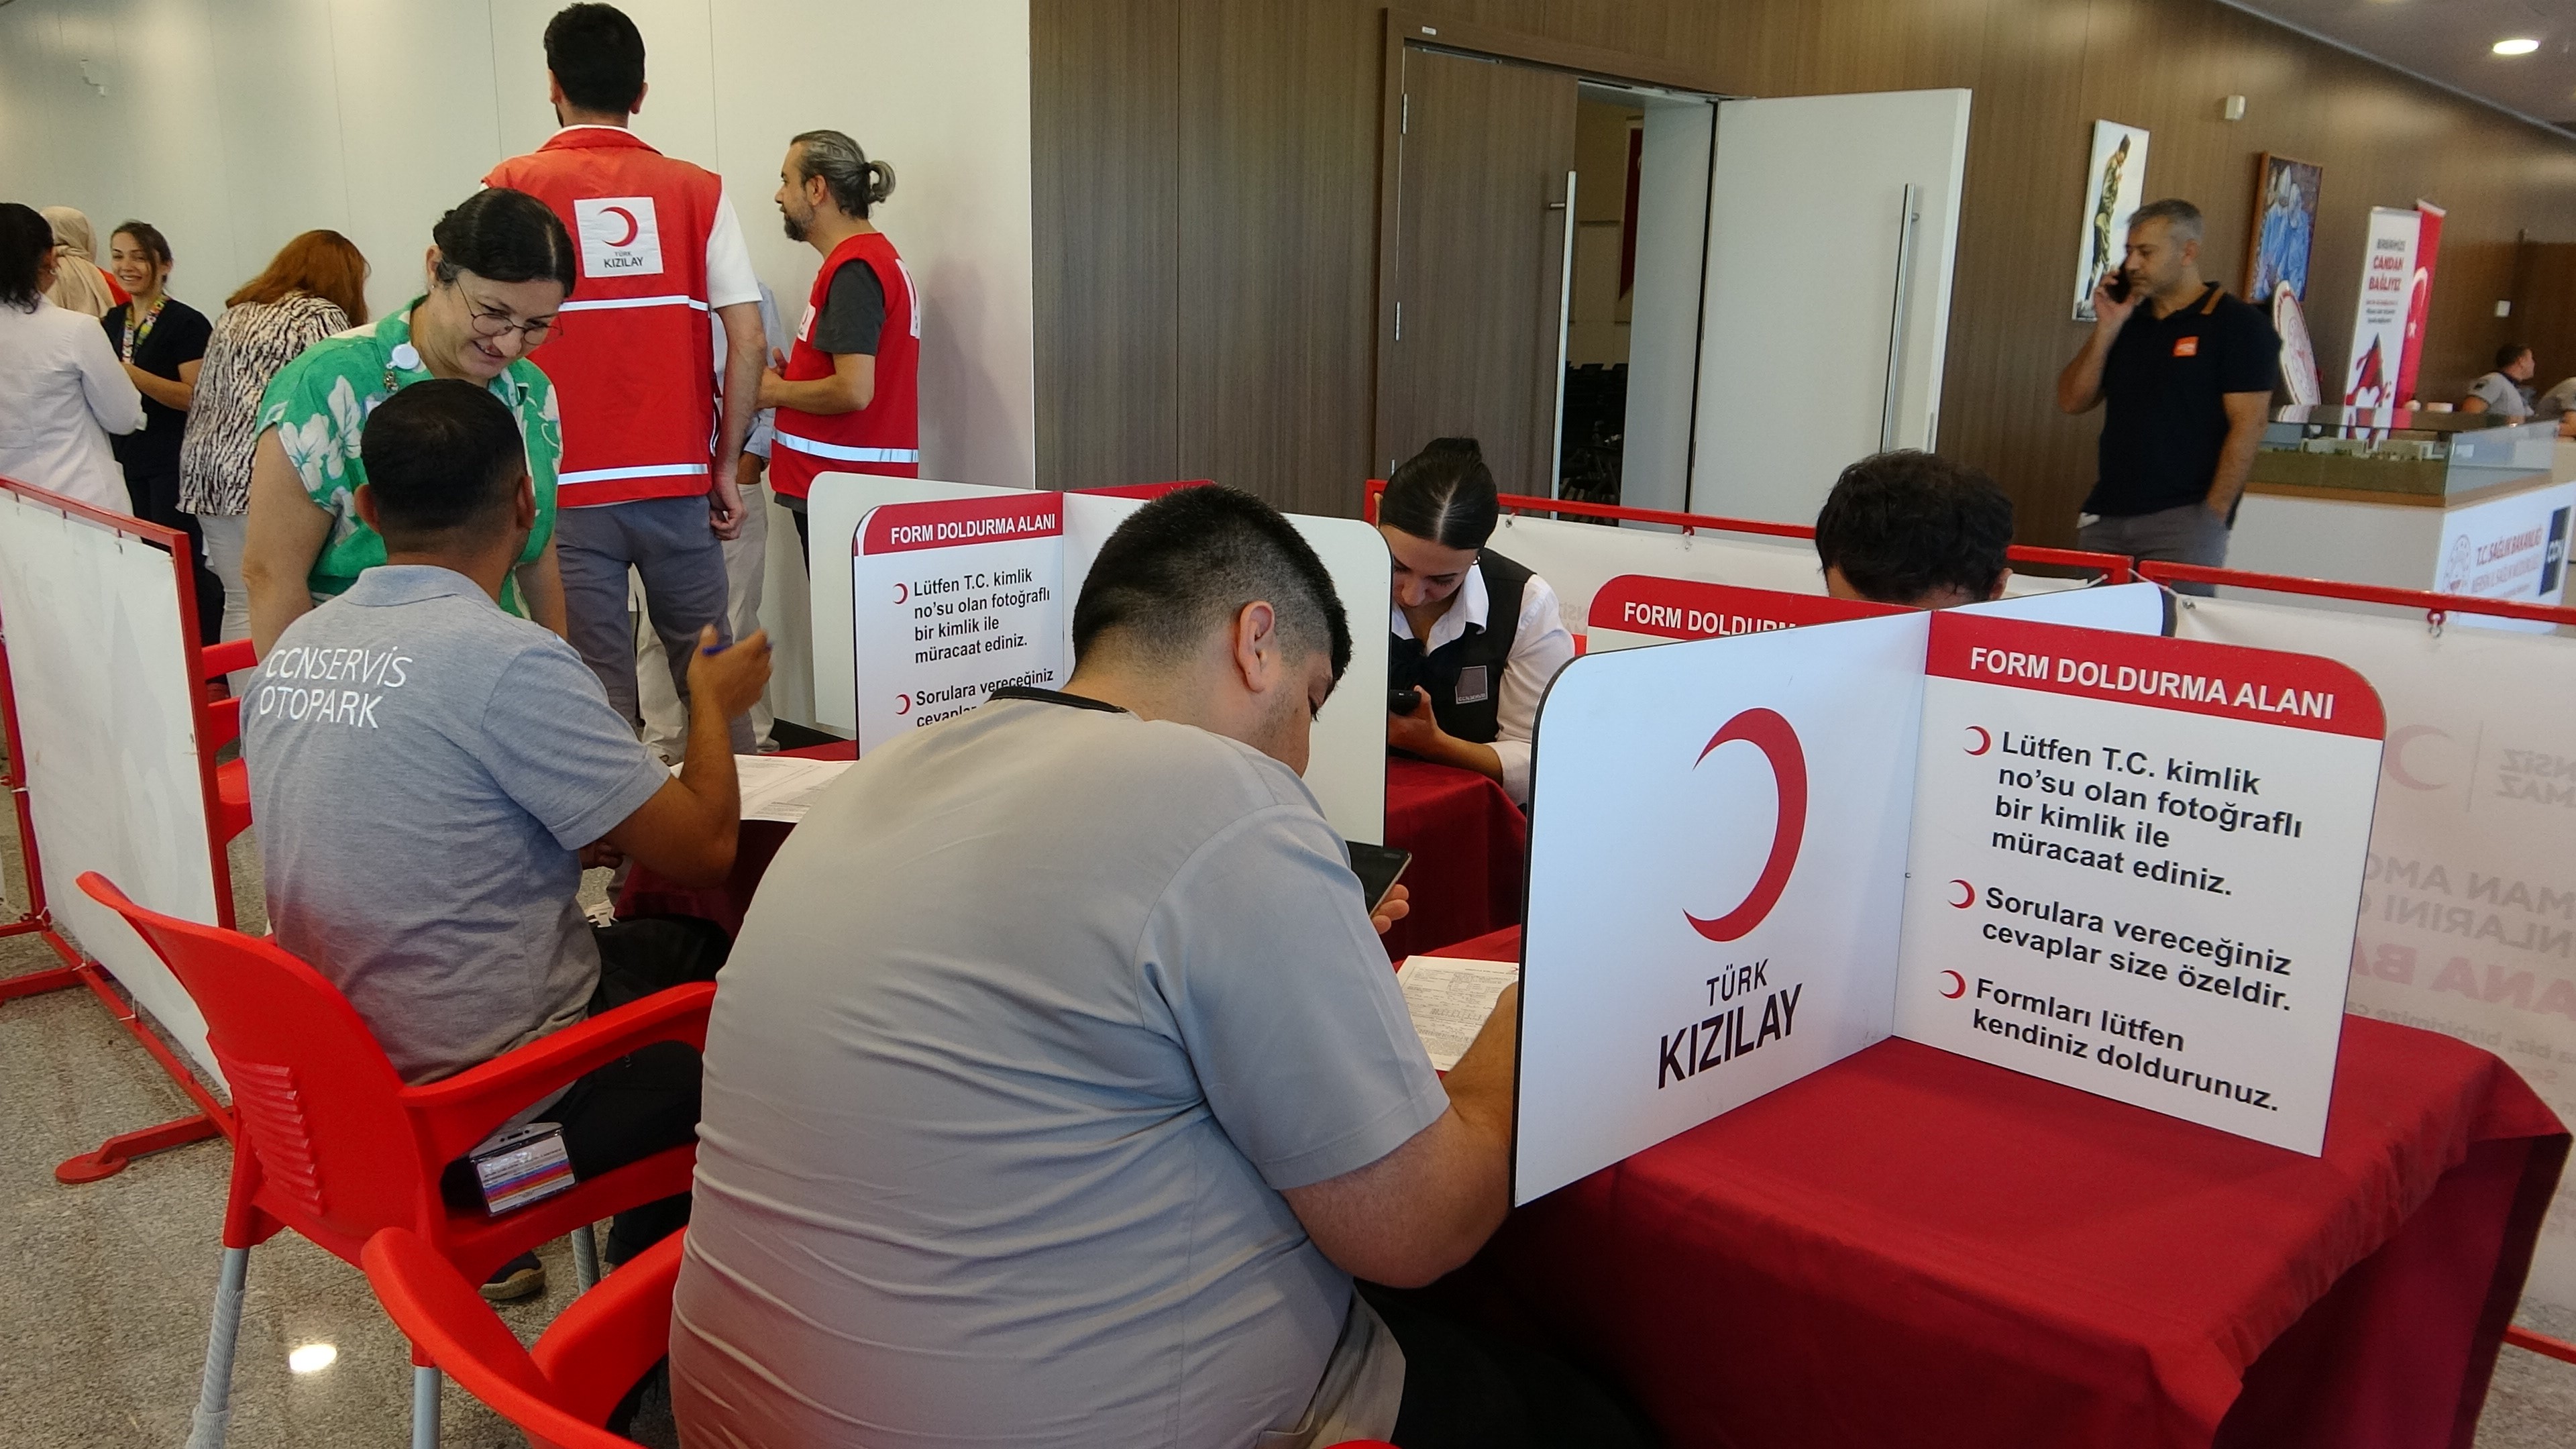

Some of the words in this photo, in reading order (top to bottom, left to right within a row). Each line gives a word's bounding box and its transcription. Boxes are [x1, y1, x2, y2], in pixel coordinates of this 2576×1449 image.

[604, 257, 643, 268] KIZILAY
[891, 525, 933, 545] FORM
[937, 517, 1015, 540] DOLDURMA
[1017, 513, 1055, 532] ALANI
[914, 576, 959, 596] Lütfen
[964, 574, 989, 590] T.C.
[994, 568, 1032, 586] kimlik
[958, 596, 987, 614] olan
[992, 587, 1050, 609] fotoğraflı
[914, 624, 934, 642] bir
[938, 619, 979, 638] kimlik
[983, 616, 1000, 632] ile
[1624, 602, 1682, 629] FORM
[266, 645, 413, 688] CCNSERVİS
[915, 640, 981, 663] müracaat
[985, 633, 1028, 653] ediniz.
[260, 686, 383, 729] OTOPARK
[916, 685, 975, 706] Sorulara
[980, 669, 1054, 694] vereceğiniz
[1970, 647, 2048, 680] FORM
[2057, 659, 2227, 704] DOLDURMA
[2235, 683, 2333, 720] ALANI
[2002, 732, 2091, 766] Lütfen
[2103, 747, 2155, 777] T.C.
[2167, 757, 2260, 796] kimlik
[1996, 795, 2032, 821] bir
[2041, 804, 2125, 840] kimlik
[2135, 822, 2169, 848] ile
[2086, 782, 2147, 810] olan
[2159, 792, 2302, 838] fotoğraflı
[1992, 830, 2123, 873] müracaat
[2133, 859, 2232, 896] ediniz.
[1986, 886, 2104, 933] Sorulara
[2114, 918, 2292, 977] vereceğiniz
[1707, 958, 1769, 1006] TÜRK
[1983, 923, 2102, 965] cevaplar
[2109, 951, 2167, 981] size
[2179, 965, 2291, 1010] özeldir.
[1658, 983, 1803, 1089] KIZILAY
[1976, 978, 2091, 1027] Formları
[2101, 1010, 2185, 1051] lütfen
[1973, 1008, 2089, 1059] kendiniz
[2097, 1046, 2278, 1112] doldurunuz.
